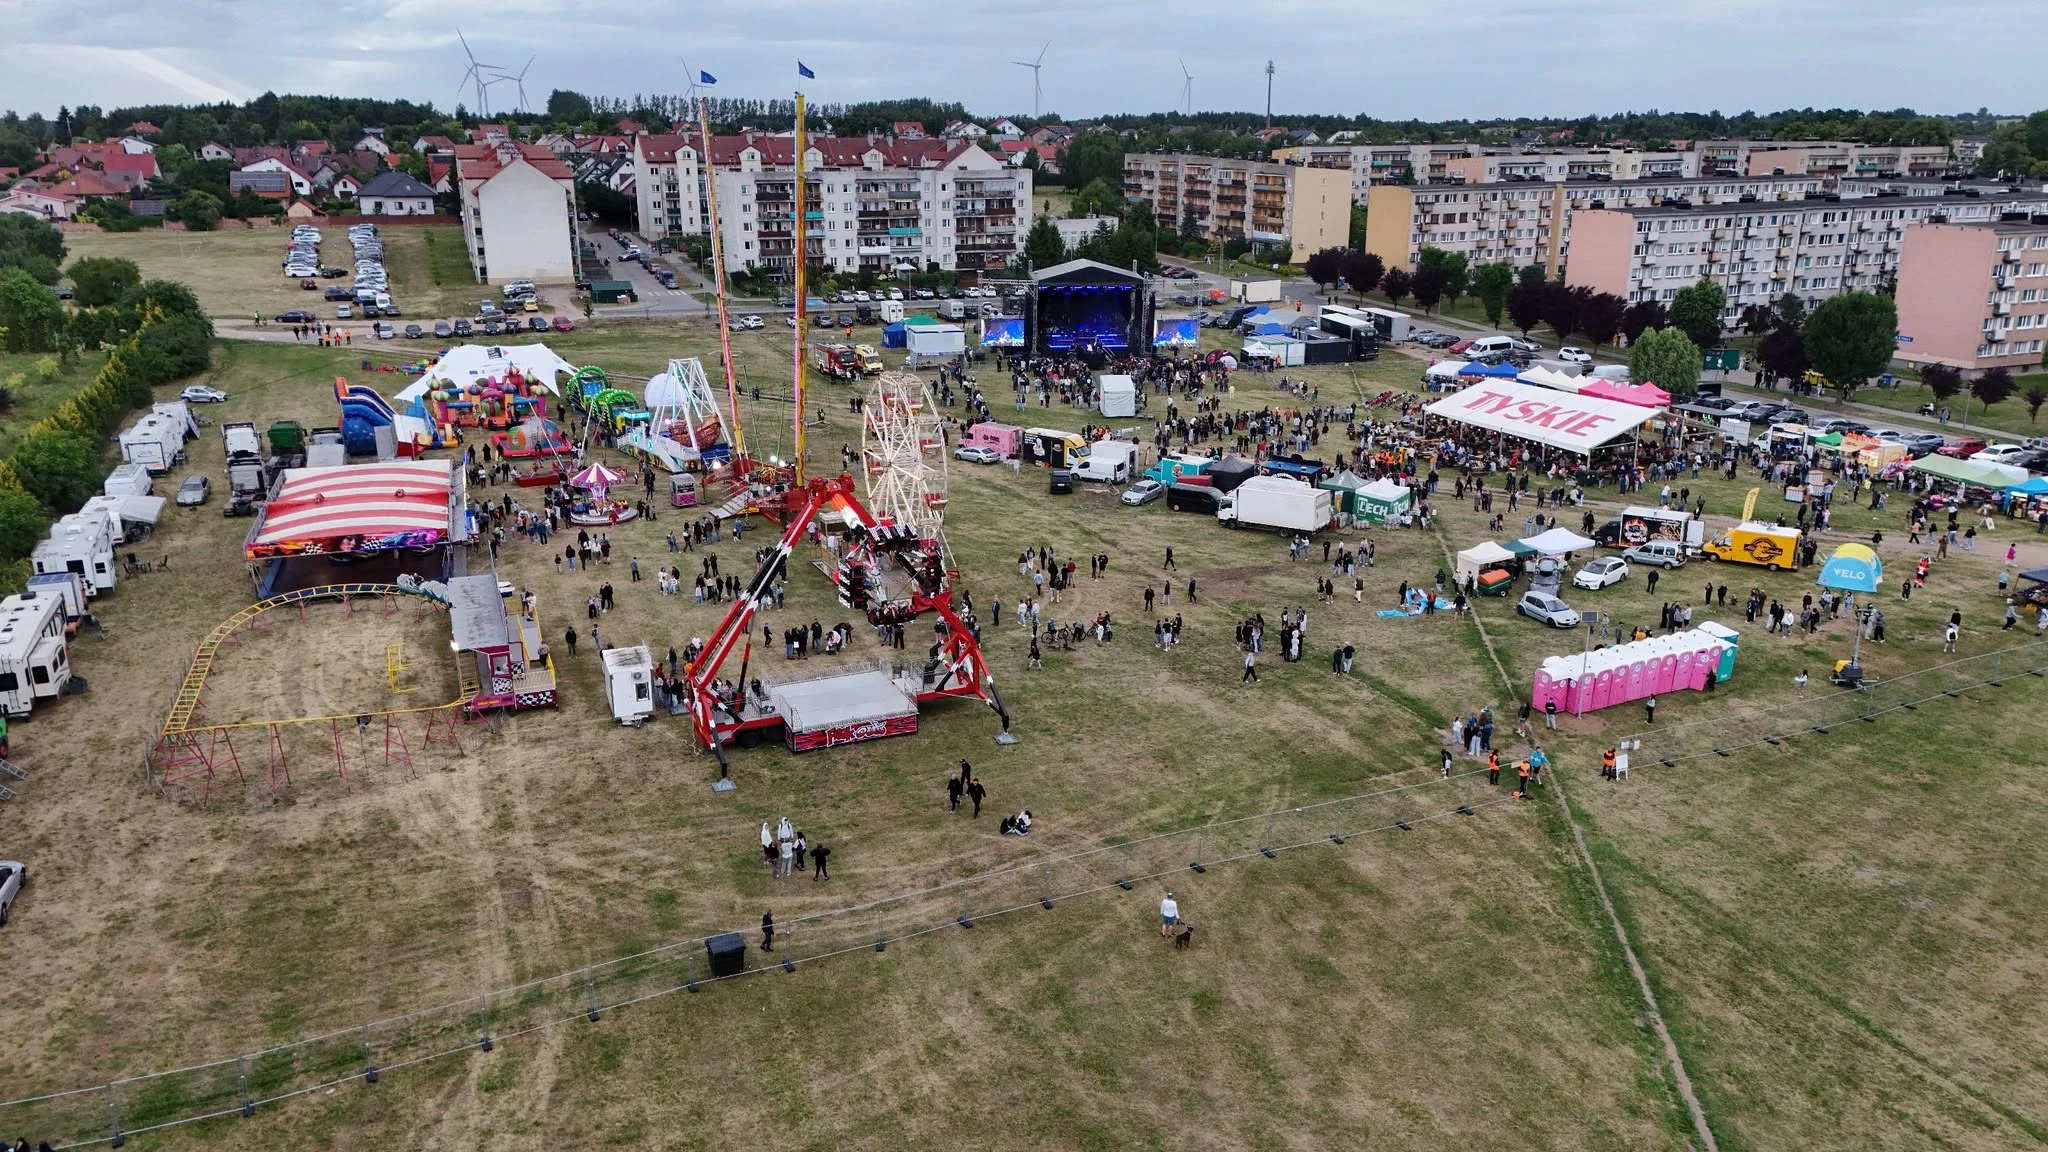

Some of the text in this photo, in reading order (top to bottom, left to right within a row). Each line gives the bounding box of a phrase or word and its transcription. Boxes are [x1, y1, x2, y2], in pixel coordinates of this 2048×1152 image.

[1463, 391, 1616, 437] TYSKIE
[1357, 497, 1388, 516] LECH
[1833, 567, 1866, 580] VELO
